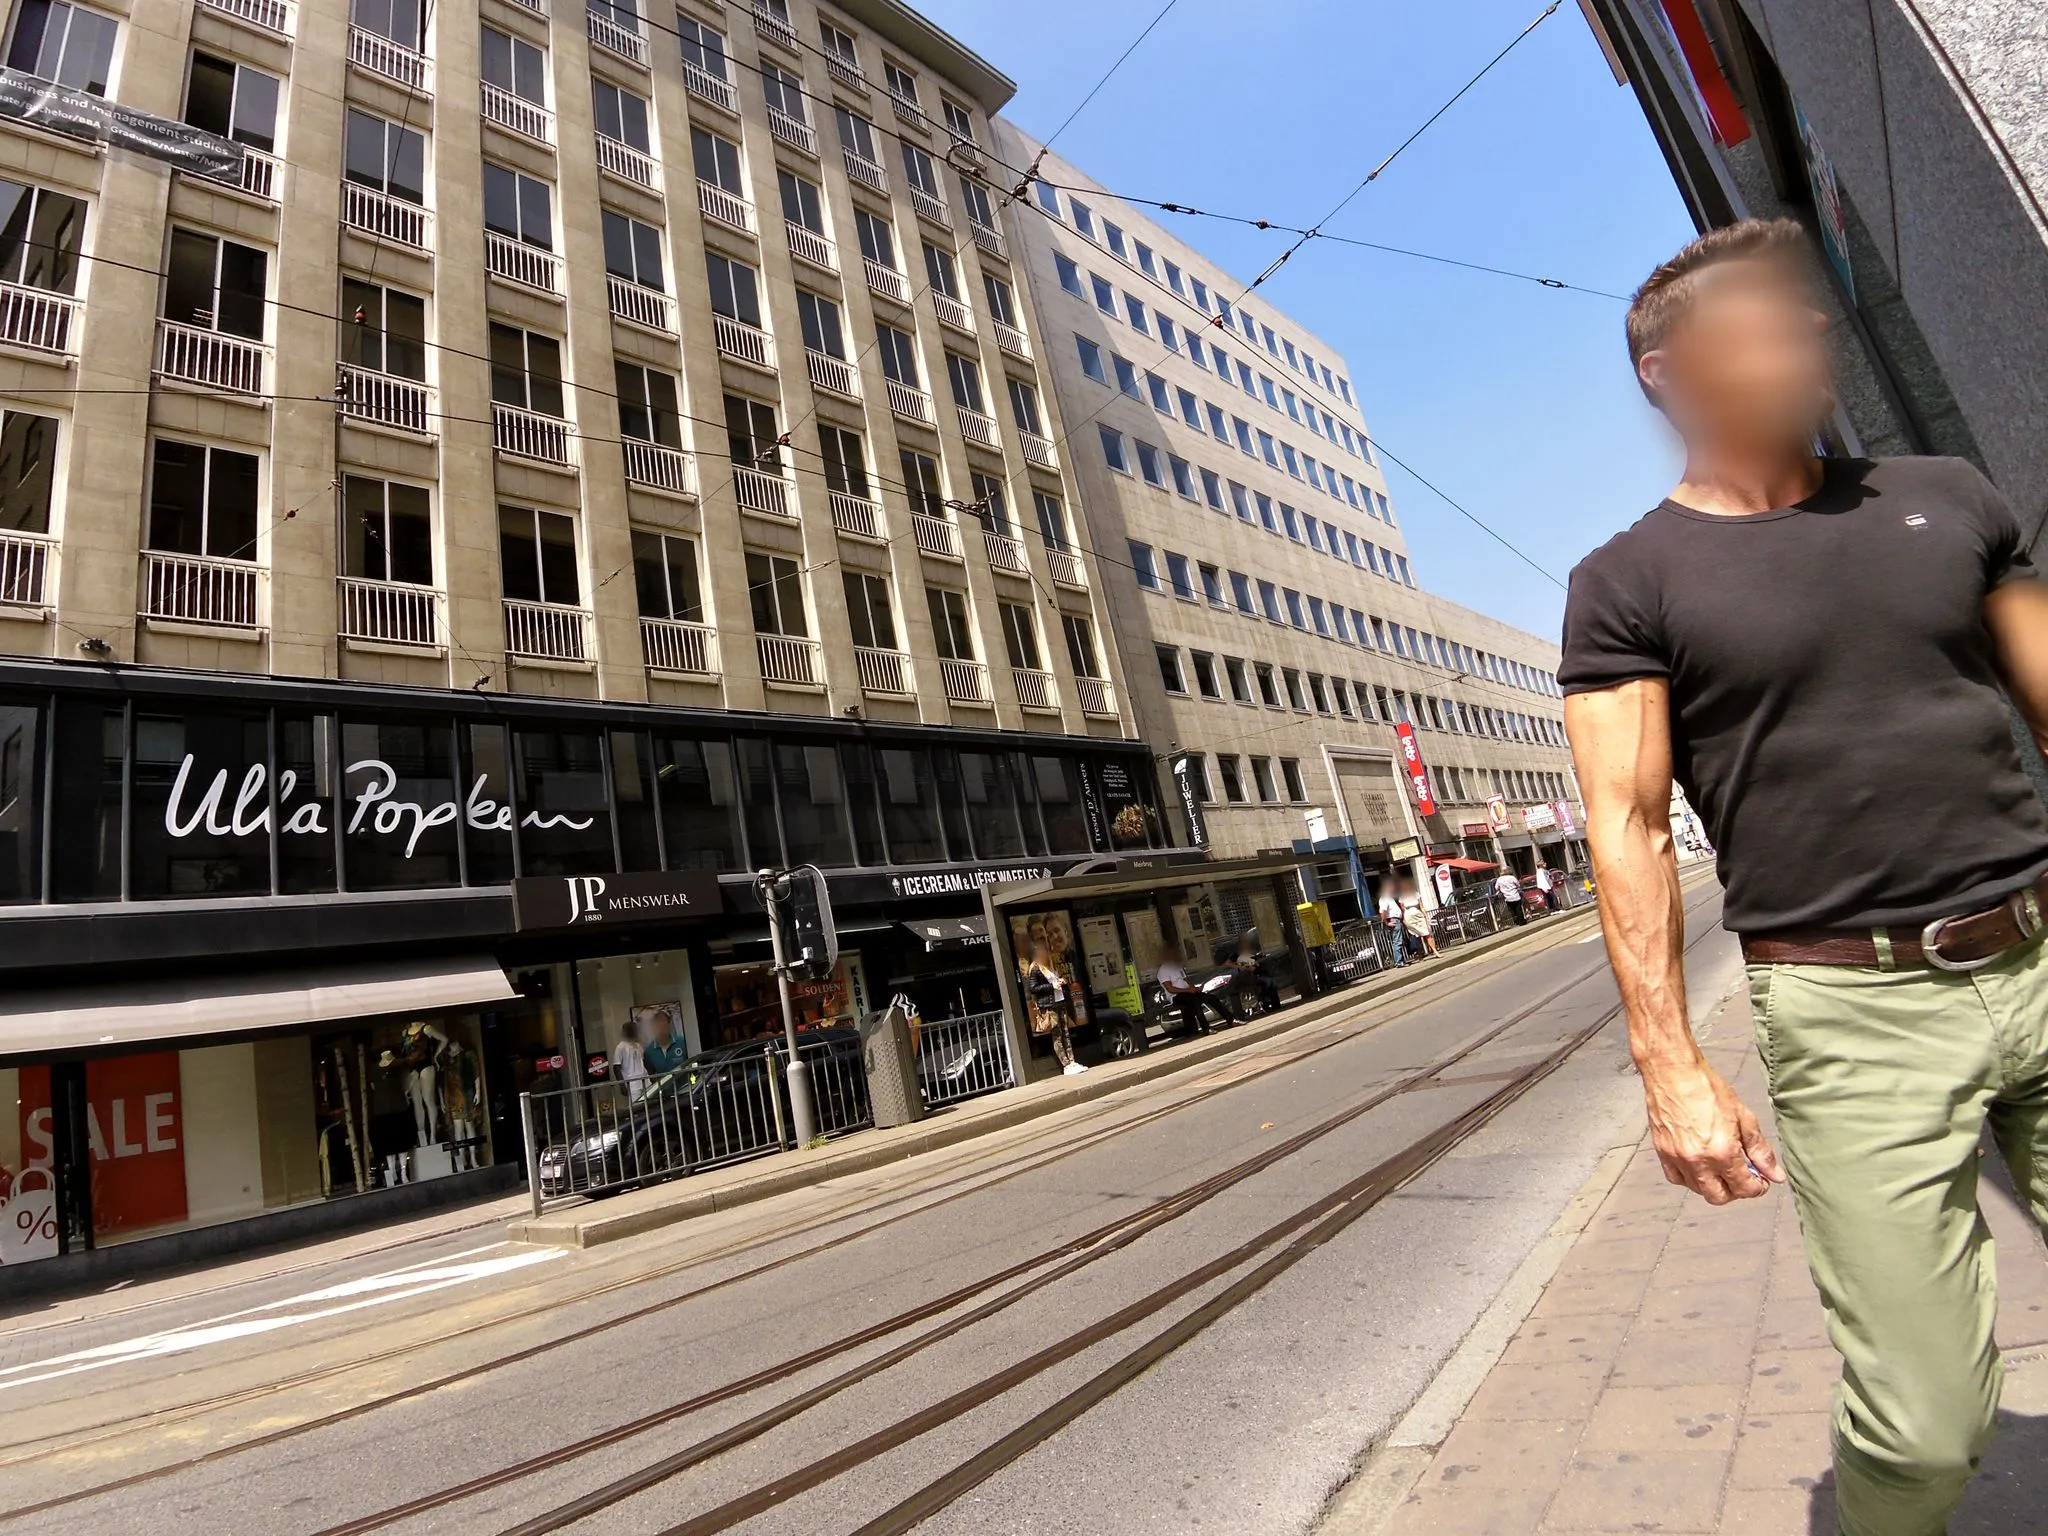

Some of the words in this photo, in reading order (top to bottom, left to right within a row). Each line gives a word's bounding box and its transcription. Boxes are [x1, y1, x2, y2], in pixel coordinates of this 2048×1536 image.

[0, 75, 58, 99] business
[62, 95, 88, 111] and
[91, 105, 180, 139] management
[183, 134, 229, 156] studies
[165, 753, 328, 837] Ulla
[345, 760, 594, 858] Popken
[1181, 774, 1203, 845] JUWELIER
[1090, 813, 1102, 844] Tresor
[564, 876, 606, 924] JP
[609, 893, 690, 910] MENSWEAR
[962, 877, 971, 890] &
[584, 913, 602, 922] 1880
[961, 935, 991, 946] TAKE
